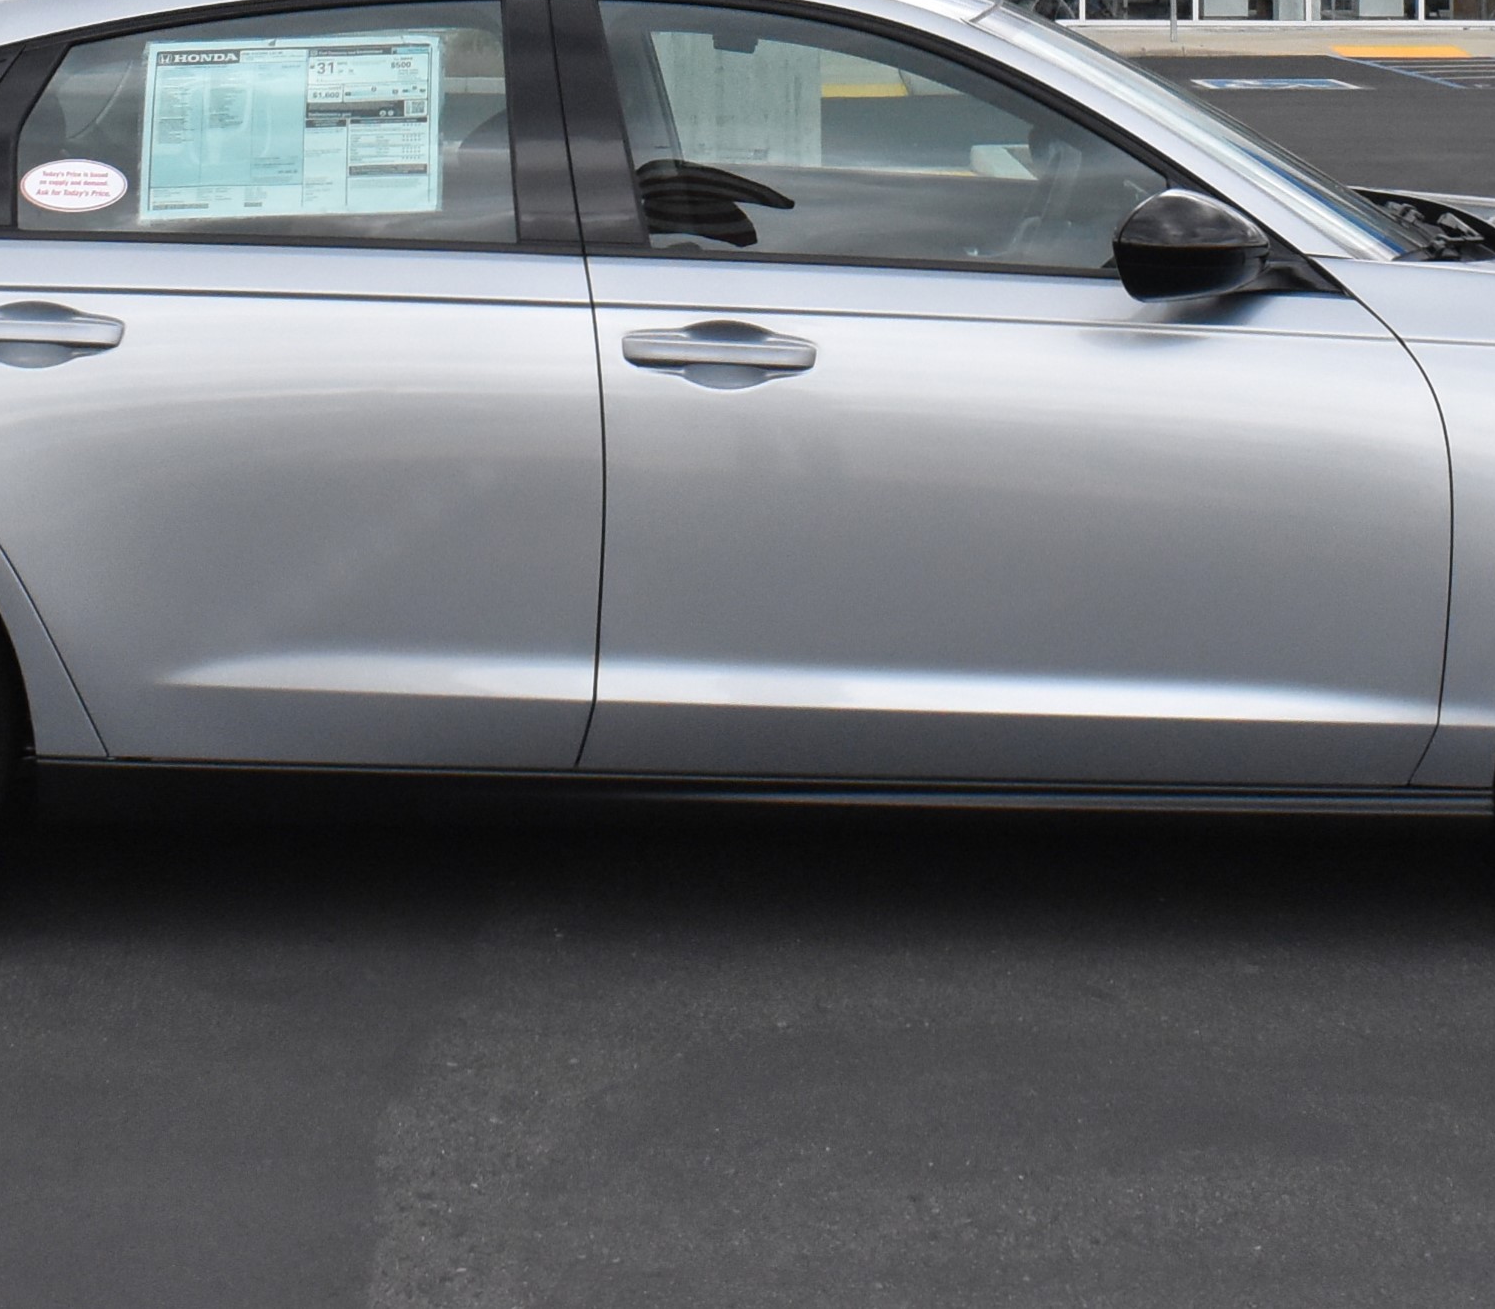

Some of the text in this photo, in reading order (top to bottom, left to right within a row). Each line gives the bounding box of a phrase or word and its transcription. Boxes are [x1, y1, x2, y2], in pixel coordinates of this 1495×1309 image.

[173, 53, 239, 63] HONDA
[316, 62, 335, 74] 31
[63, 189, 89, 198] Today's
